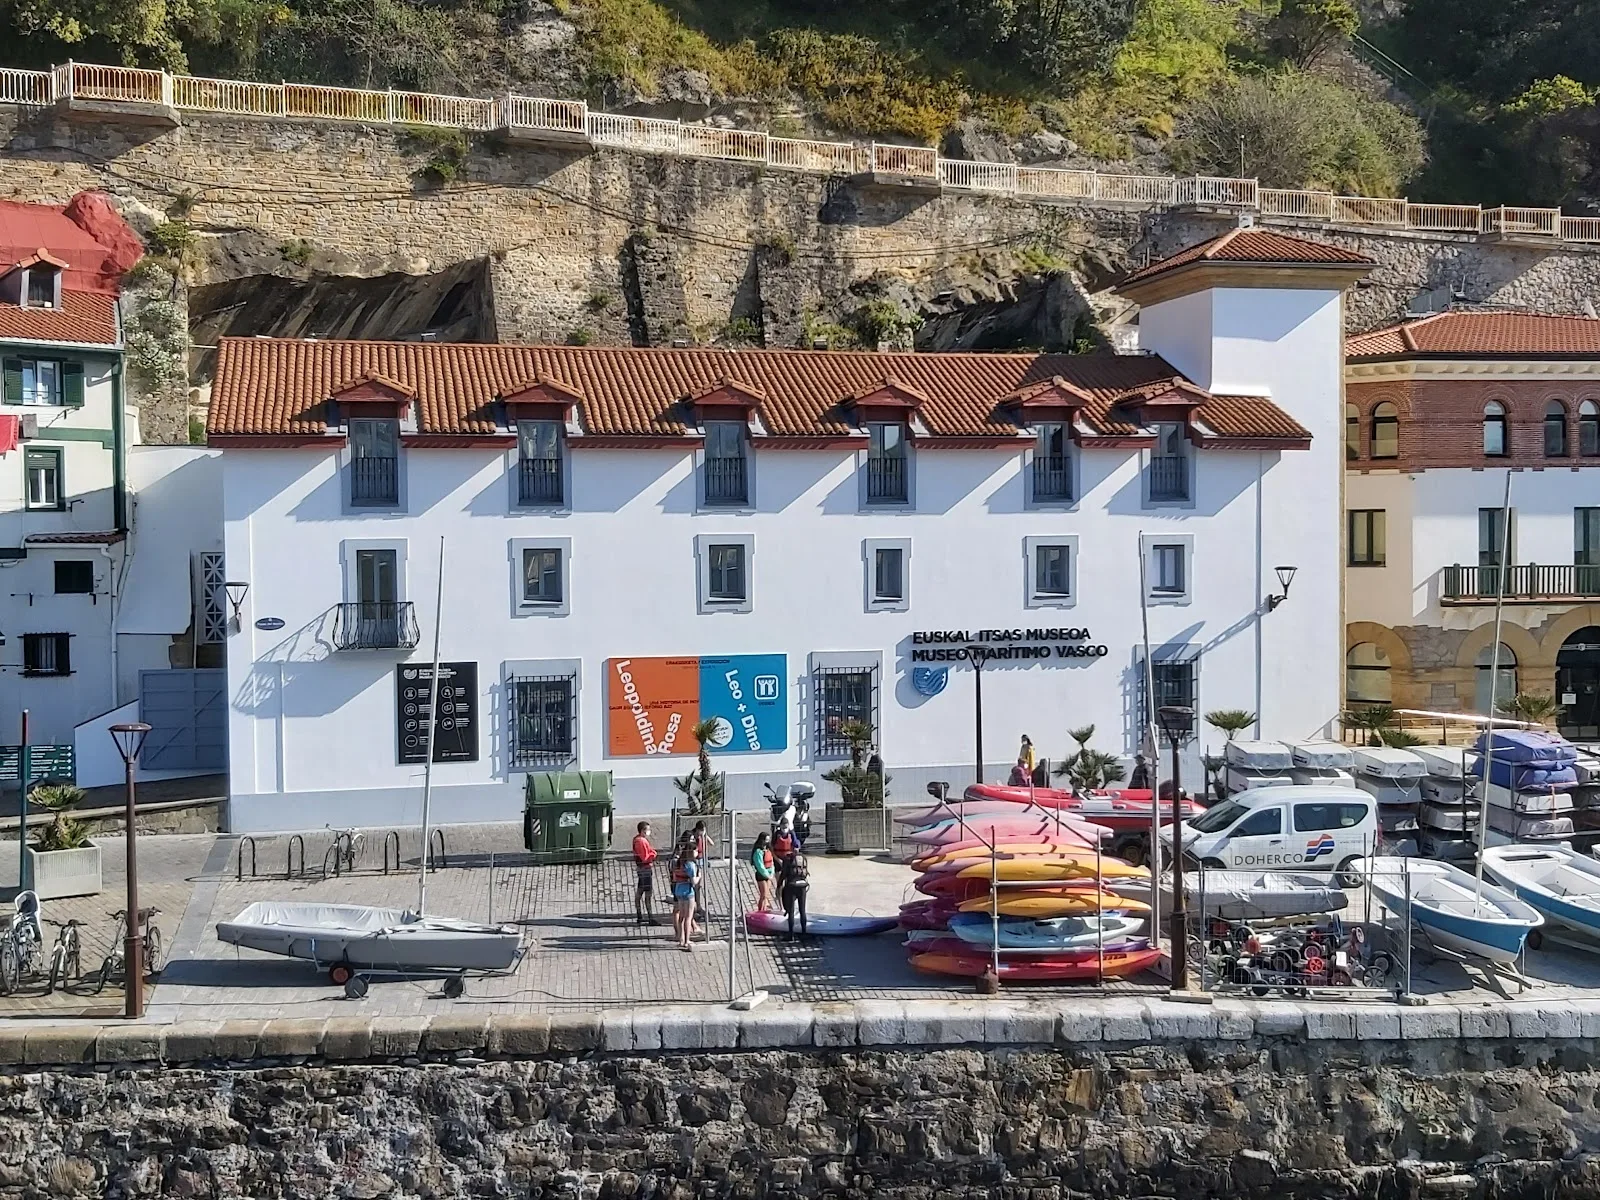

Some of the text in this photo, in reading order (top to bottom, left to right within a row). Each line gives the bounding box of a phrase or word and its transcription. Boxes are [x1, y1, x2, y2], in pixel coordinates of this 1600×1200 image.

[913, 628, 1091, 644] EUSKAL ITSAS MUSEOA
[912, 644, 1108, 662] MUSEO MARÍTIMO VASCO
[616, 660, 658, 755] Leopoldina
[725, 669, 743, 700] Leo
[740, 714, 761, 751] Dina
[657, 713, 682, 754] Rosa
[1234, 853, 1303, 866] DOHERCO
